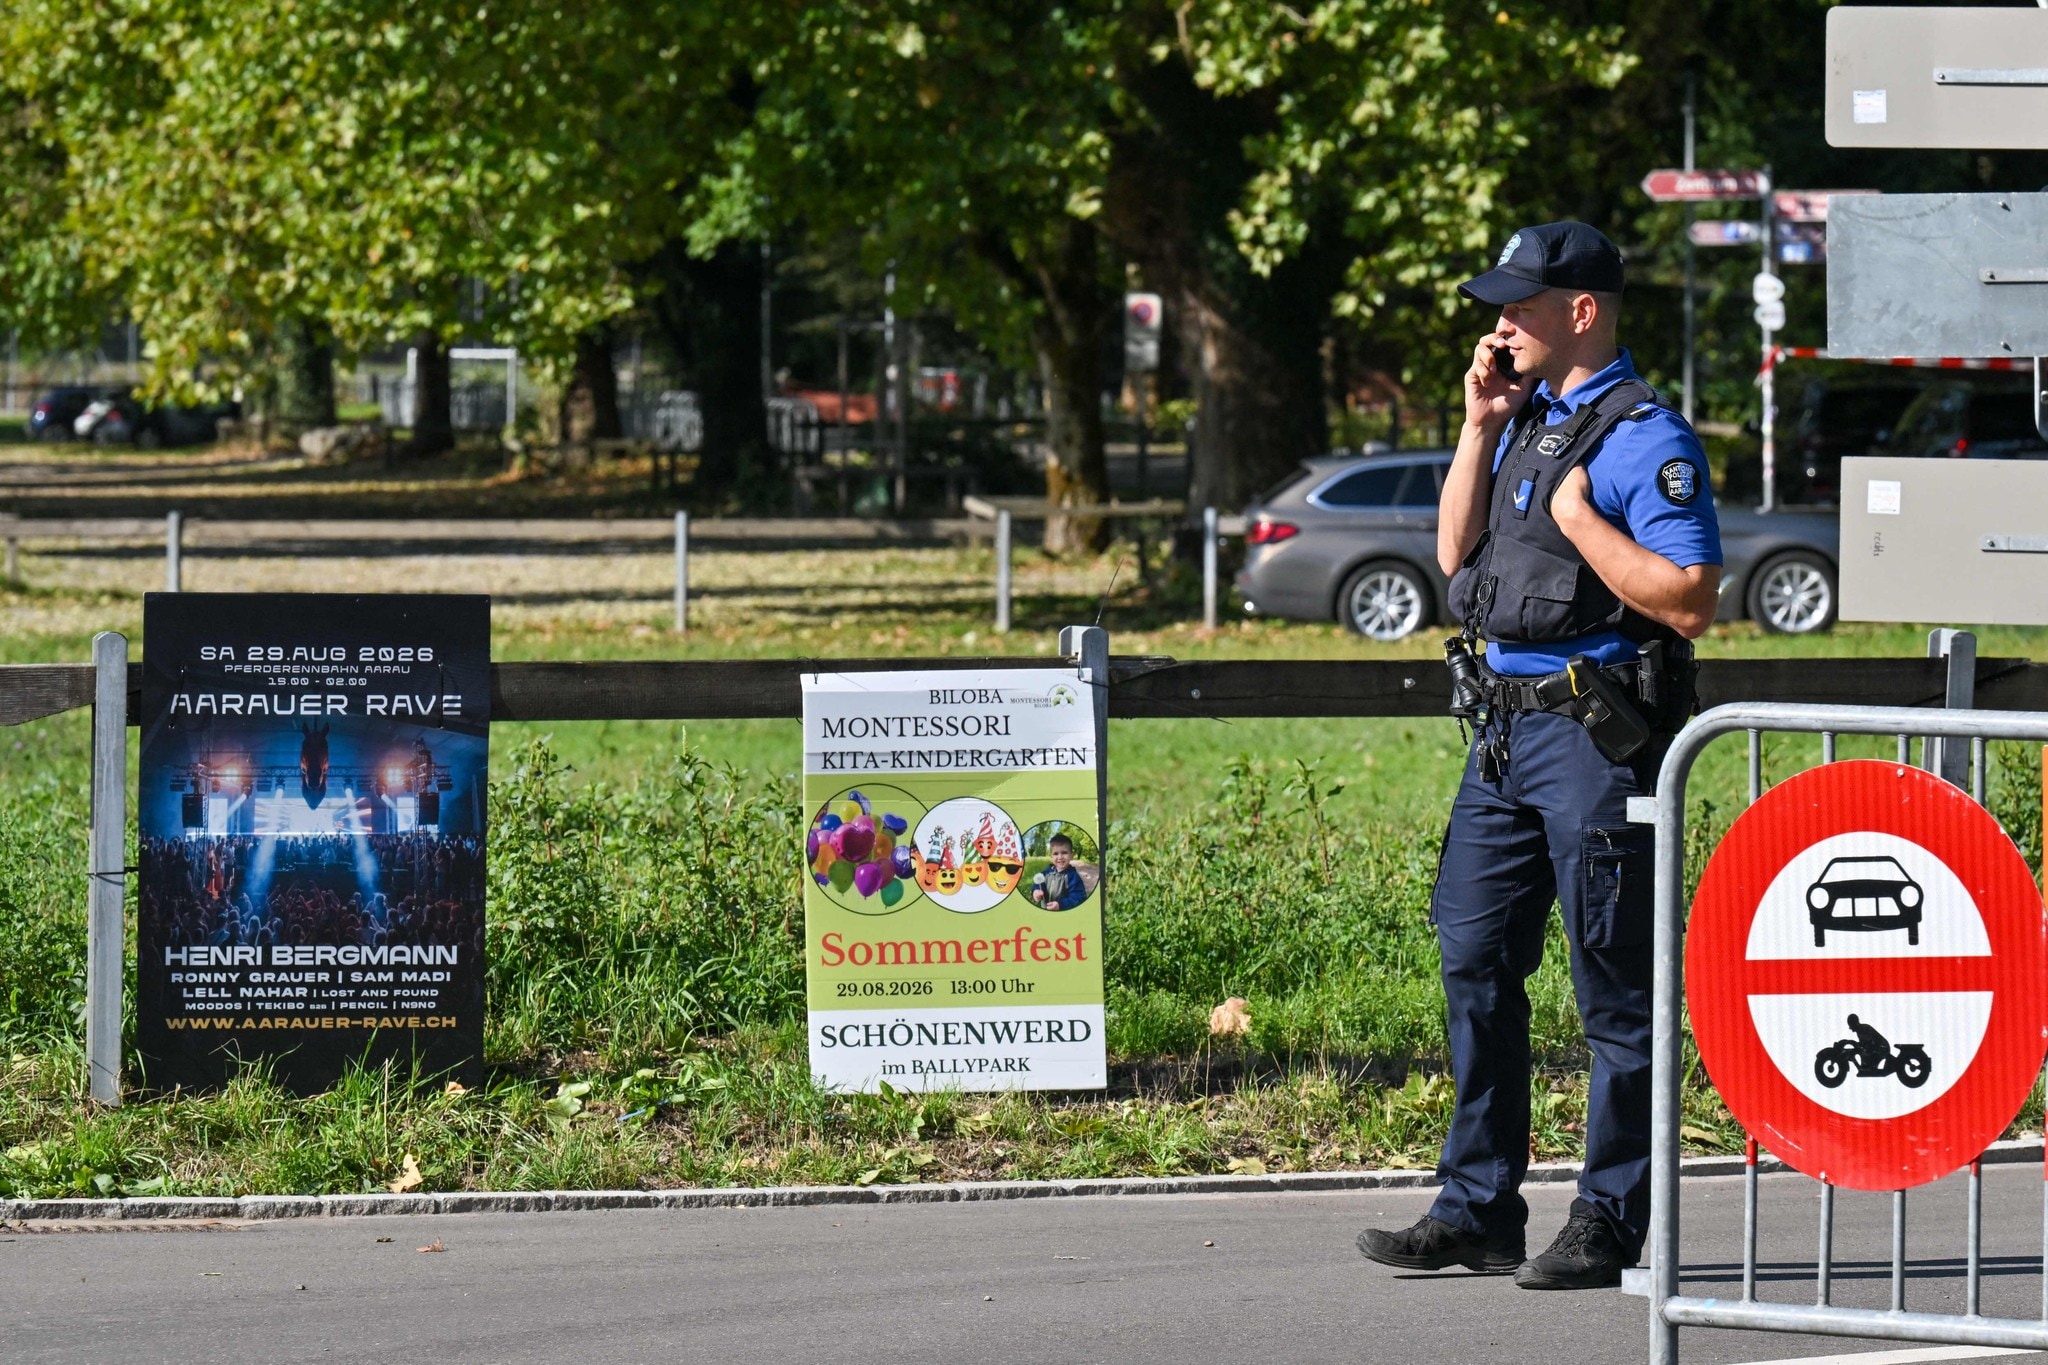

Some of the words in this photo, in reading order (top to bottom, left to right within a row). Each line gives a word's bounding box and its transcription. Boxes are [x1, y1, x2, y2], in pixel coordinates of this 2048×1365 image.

[1670, 487, 1692, 495] AARGAU
[201, 647, 234, 660] SA
[248, 647, 345, 660] 29.AUG
[359, 648, 433, 661] 2026
[224, 664, 359, 674] PFERDERENNBAHN
[364, 665, 411, 674] AARAU
[268, 677, 310, 686] 15.00
[325, 677, 367, 686] 02.00
[930, 689, 1003, 704] BILOBA
[171, 694, 347, 715] AARAUER
[367, 695, 461, 715] RAVE
[822, 716, 1010, 738] MONTESSORI
[821, 747, 1087, 770] KITA-KINDERGARTEN
[821, 926, 1088, 967] Sommerfest
[166, 946, 262, 965] HENRI
[272, 945, 457, 965] BERGMANN
[171, 972, 241, 983] RONNY
[248, 972, 330, 983] GRAUER
[350, 971, 394, 983] SAM
[401, 971, 451, 982] MADI
[182, 987, 232, 998] LELL
[239, 986, 308, 998] NAHAR
[321, 989, 356, 998] LOST
[360, 989, 389, 997] AND
[393, 988, 439, 997] FOUND
[837, 981, 932, 996] 29.08.2026
[950, 979, 997, 995] 13:00
[1001, 978, 1035, 994] Uhr
[185, 1002, 243, 1011] MOODOS
[255, 1001, 305, 1010] TEKIBO
[339, 1001, 388, 1010] PENCIL
[165, 1016, 457, 1029] WWW.AARAUER-RAVE.CH
[821, 1019, 1091, 1048] SCHÖNENWERD
[881, 1059, 906, 1075] im
[911, 1057, 1032, 1075] BALLYPARK
